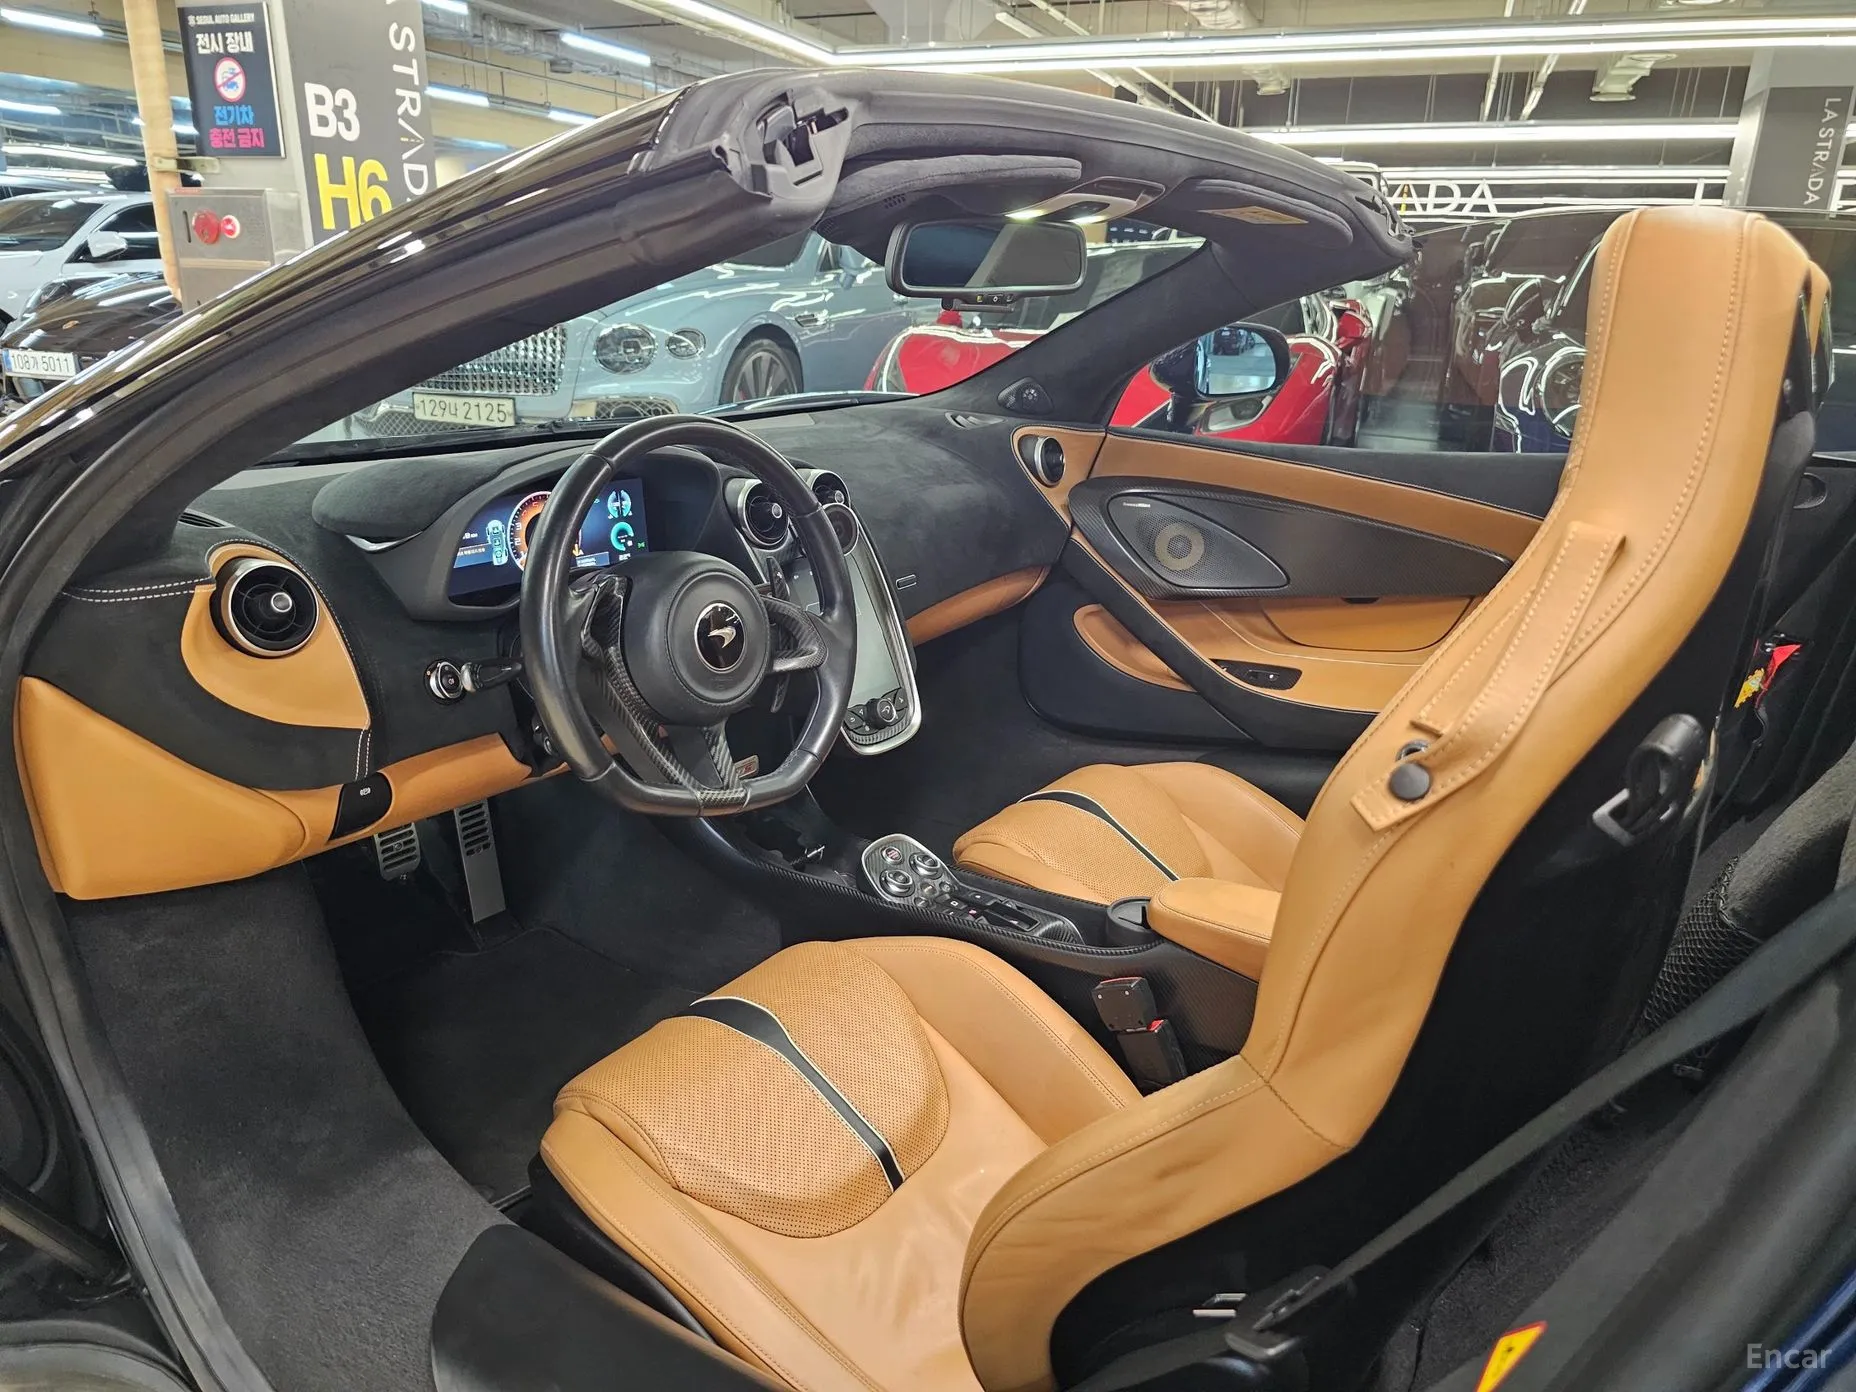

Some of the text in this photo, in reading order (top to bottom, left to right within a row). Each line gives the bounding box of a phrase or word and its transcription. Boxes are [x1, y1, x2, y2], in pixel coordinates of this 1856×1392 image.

[215, 14, 230, 24] AUTO
[230, 12, 255, 23] GALLERY
[196, 31, 254, 54] 전시 장내
[213, 105, 254, 126] 전기차
[304, 82, 360, 141] B3
[389, 22, 429, 201] STRAD
[210, 128, 265, 148] 충전 금지
[1803, 98, 1842, 205] LA STRADA
[314, 153, 393, 230] H6
[1391, 179, 1498, 214] ADA
[41, 355, 70, 373] 5011
[419, 399, 508, 423] 129나 2125
